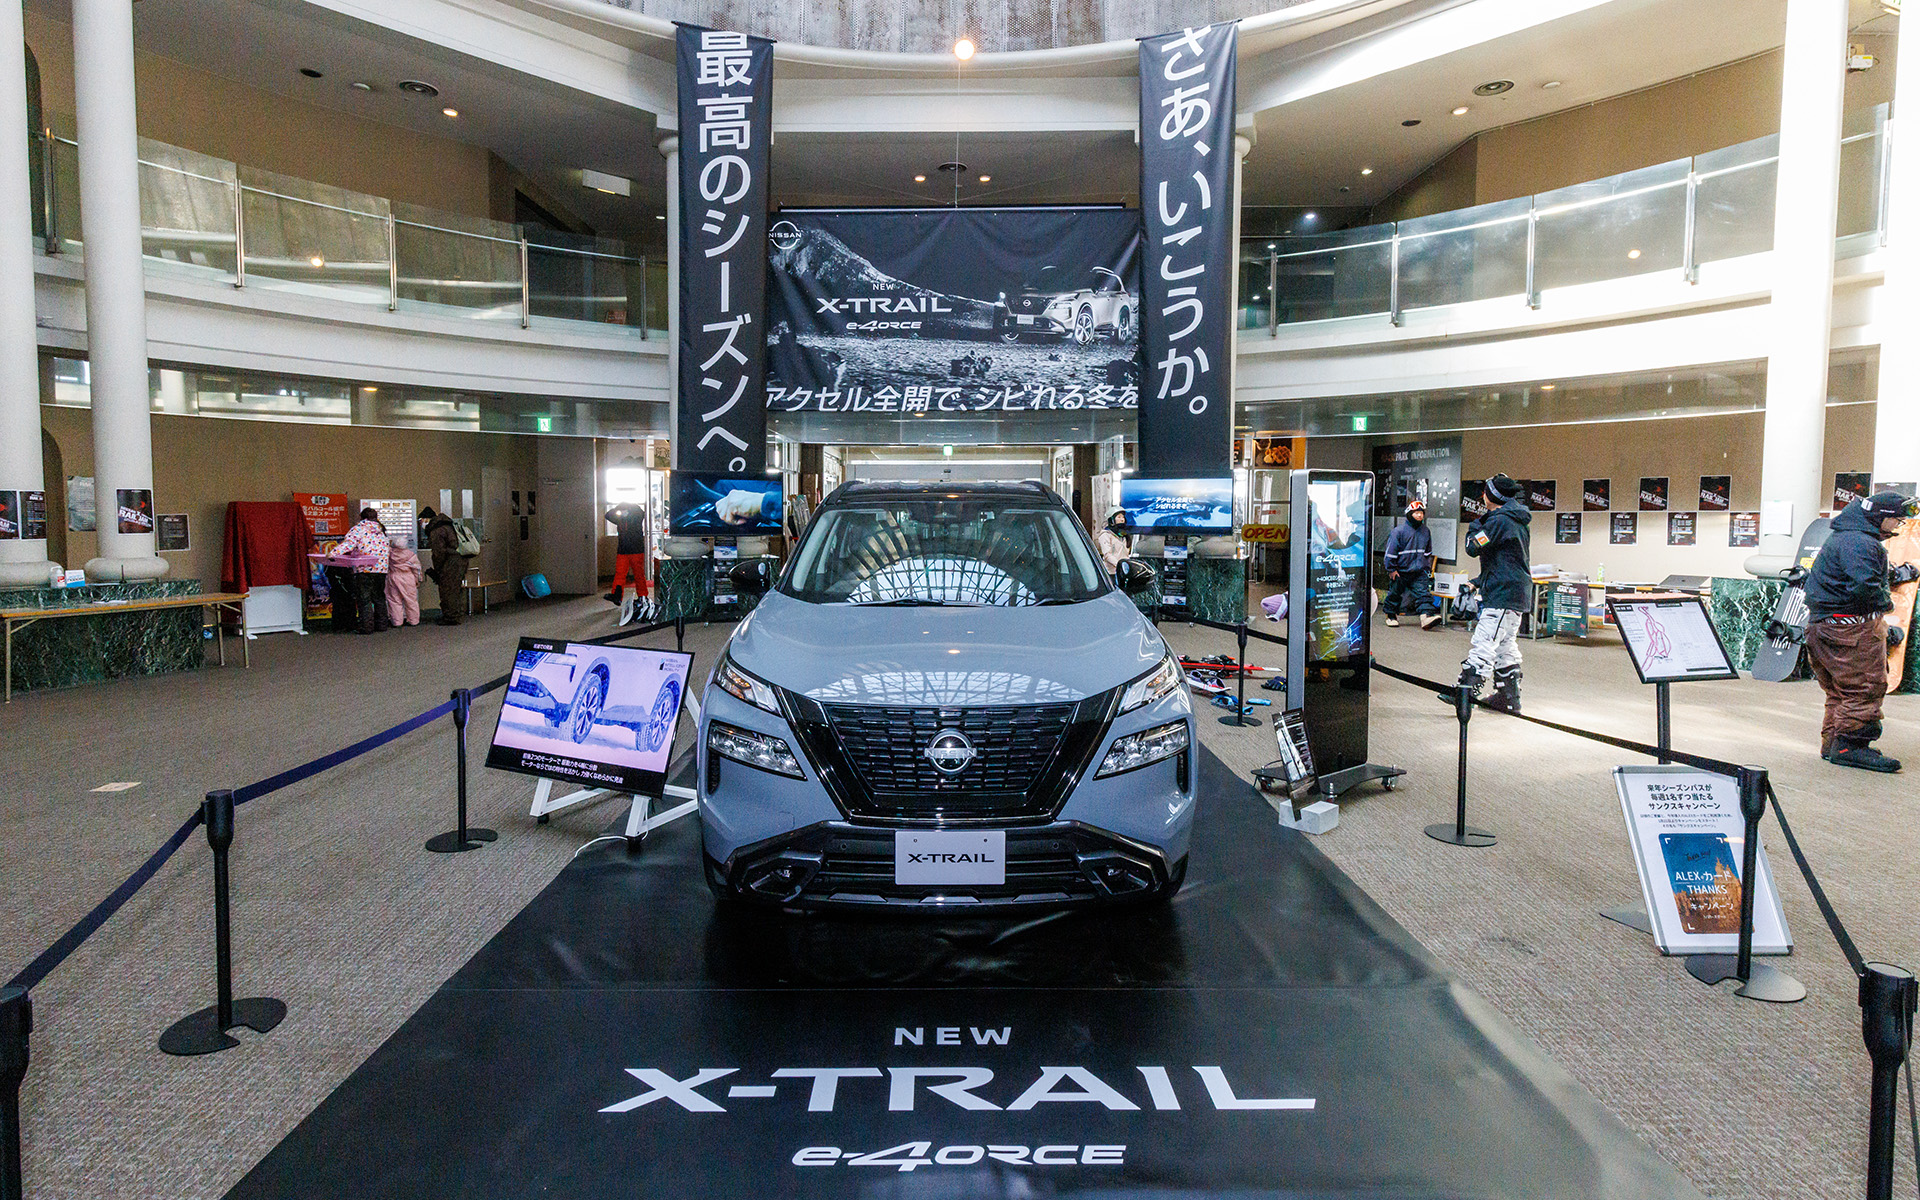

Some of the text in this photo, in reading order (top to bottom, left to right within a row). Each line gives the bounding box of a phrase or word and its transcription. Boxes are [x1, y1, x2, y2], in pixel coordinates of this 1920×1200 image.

[1157, 24, 1213, 416] さあ、いこうか。
[696, 31, 754, 472] 最高のシーズンへ。
[872, 282, 894, 291] NEW
[816, 297, 952, 314] X-TRAIL
[766, 384, 1138, 412] アクセル全開で、シビれる冬を
[1410, 447, 1450, 460] INFORMATION
[1243, 527, 1287, 540] OPEN
[1647, 784, 1713, 792] 来年シーズンパスが
[1651, 793, 1714, 801] 毎週1名ずつ当たる
[1648, 802, 1721, 811] サンクスキャンペーン
[907, 852, 995, 863] X-TRAIL
[1687, 885, 1728, 895] THANKS
[1690, 902, 1734, 911] キャンペーン
[894, 1027, 1012, 1045] NEW
[598, 1066, 1316, 1113] X-TRAIL
[792, 1141, 1126, 1172] e-4ORCE
